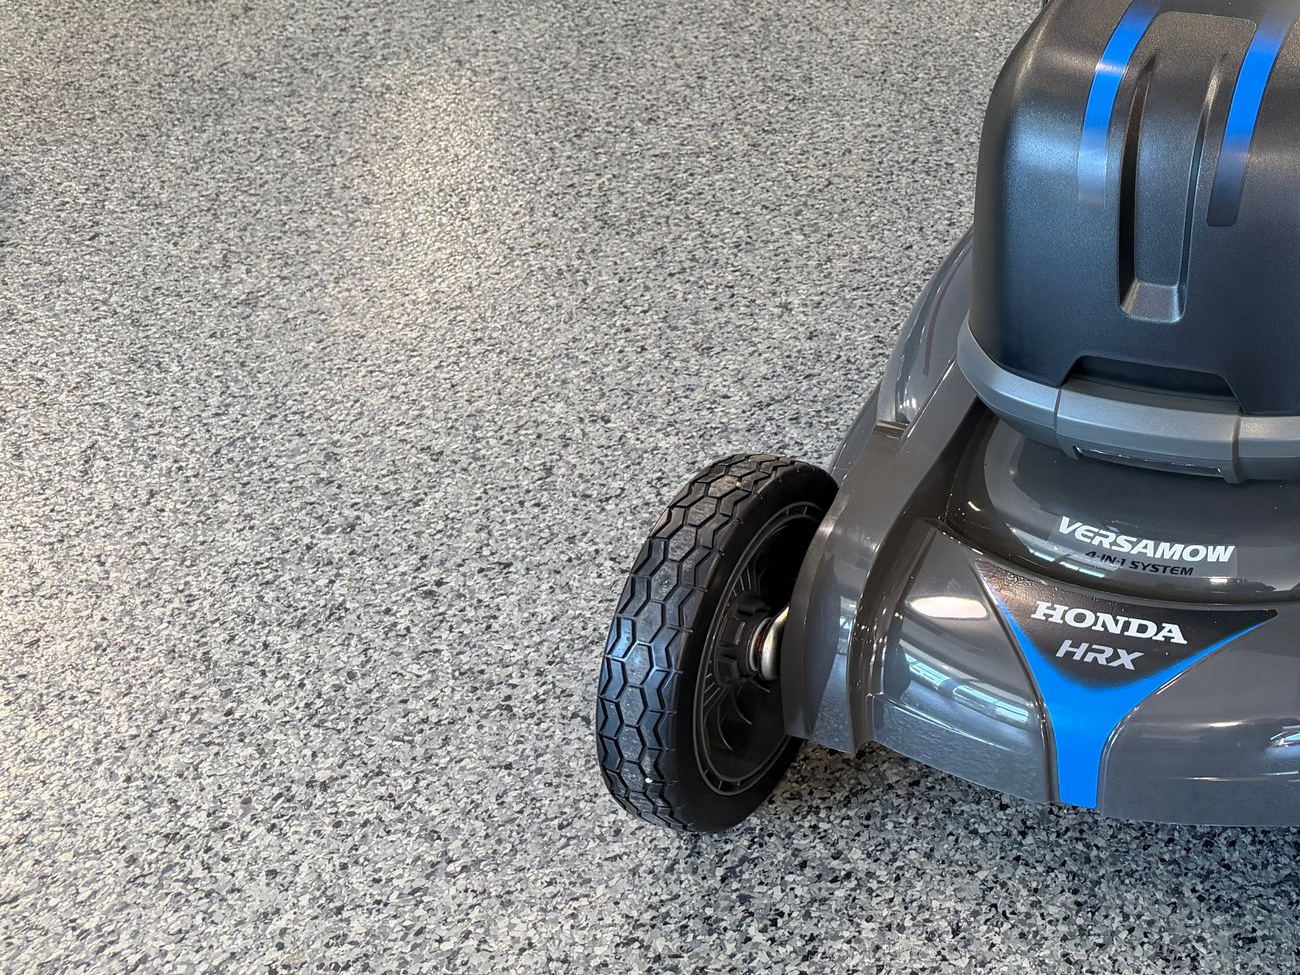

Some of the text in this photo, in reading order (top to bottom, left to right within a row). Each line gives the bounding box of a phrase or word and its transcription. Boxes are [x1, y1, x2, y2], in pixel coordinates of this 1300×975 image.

[1057, 515, 1236, 563] VERSAMOW
[1084, 550, 1195, 577] 4-IN-1 SYSTEM
[1030, 600, 1188, 645] HONDA
[1055, 638, 1145, 671] HRX
